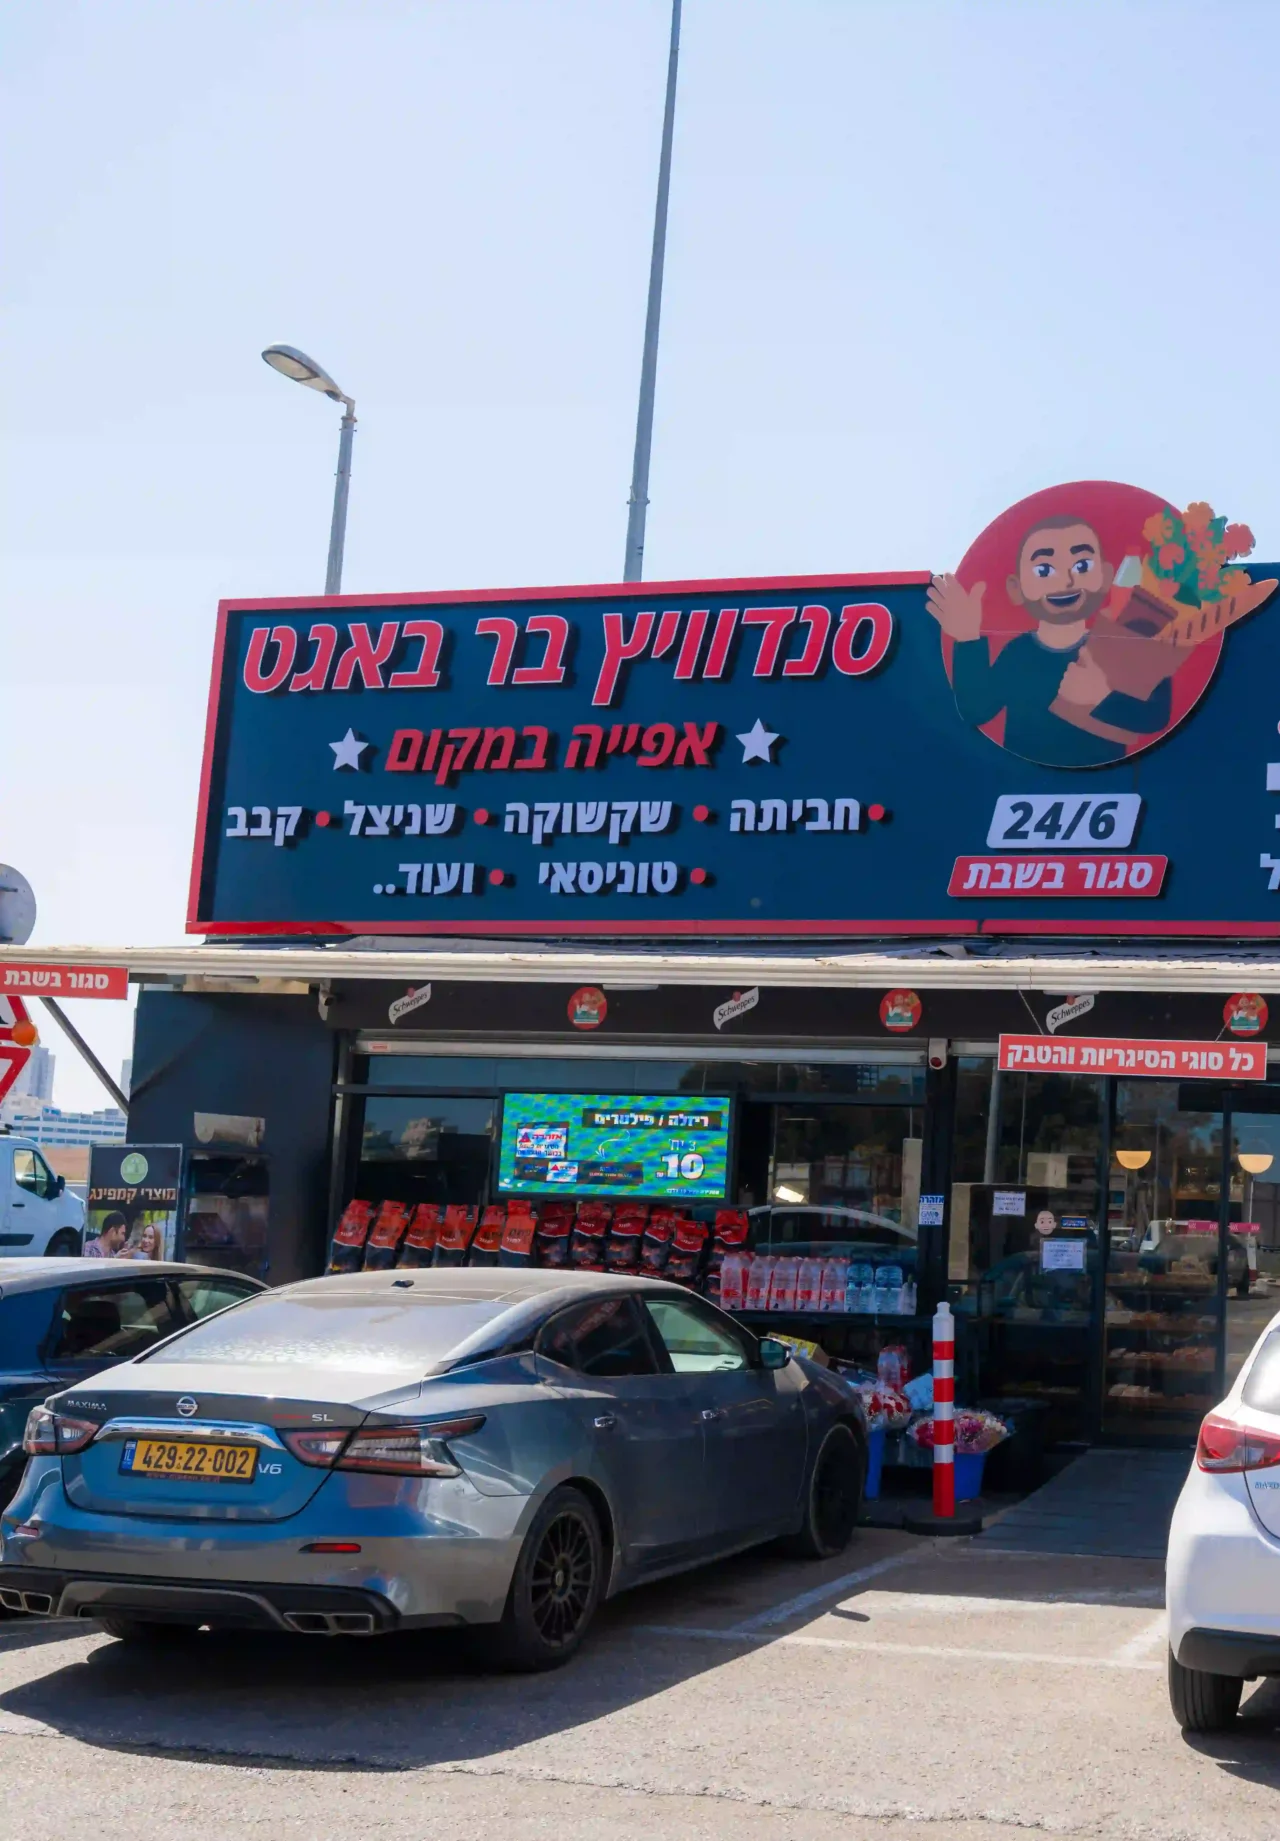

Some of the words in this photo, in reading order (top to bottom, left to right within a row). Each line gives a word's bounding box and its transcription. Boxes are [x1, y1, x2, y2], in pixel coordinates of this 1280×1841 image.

[243, 619, 445, 693] באגט
[474, 615, 570, 686] בר
[592, 602, 893, 706] סנדוויץ
[384, 727, 549, 786] במקום
[564, 721, 719, 767] אפייה
[227, 805, 301, 847] קבב
[343, 802, 456, 838] שניצל
[504, 800, 671, 845] שקשוקה
[730, 797, 860, 832] חביתה
[1002, 801, 1119, 841] 24/6
[538, 859, 678, 893] טוניסאי
[963, 863, 1066, 890] בשבת
[1078, 862, 1153, 889] סגור
[4, 970, 62, 987] בשבת
[67, 973, 109, 989] סגור
[718, 995, 755, 1021] Schweppes
[1051, 998, 1091, 1025] Schweppes
[1007, 1044, 1075, 1067] והטבק
[1080, 1047, 1175, 1068] הסיגריות
[1182, 1050, 1223, 1070] סוגי
[1230, 1048, 1254, 1070] כל
[595, 1113, 654, 1125] פילטרים
[662, 1154, 704, 1179] 10
[89, 1188, 137, 1204] קמפינג
[140, 1188, 176, 1200] מוצרי
[67, 1400, 107, 1410] MAXIMA
[311, 1413, 334, 1422] SL
[258, 1463, 282, 1474] V6
